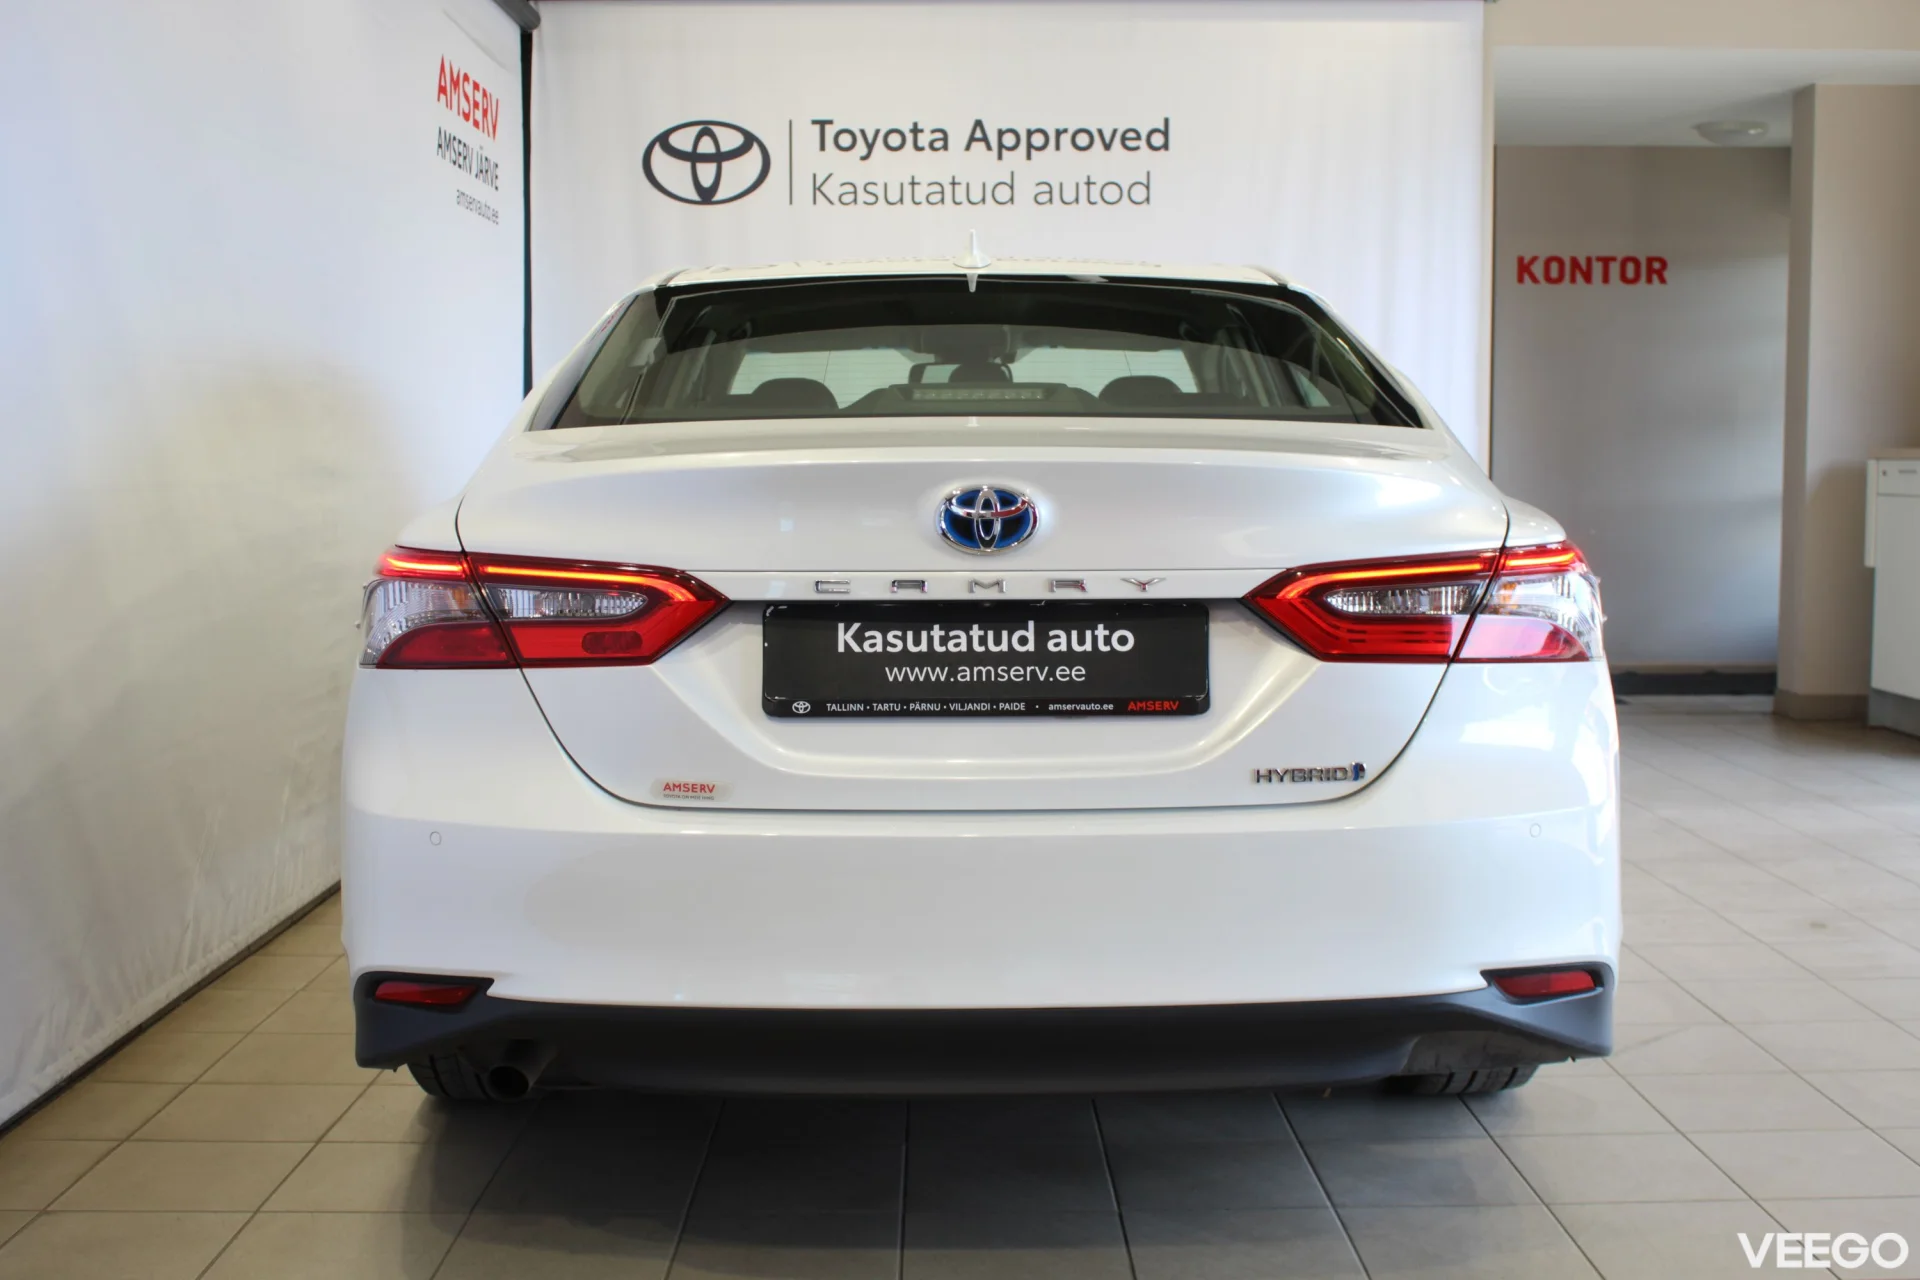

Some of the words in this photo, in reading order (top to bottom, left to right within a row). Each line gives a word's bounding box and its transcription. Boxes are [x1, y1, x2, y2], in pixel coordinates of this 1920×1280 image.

[437, 54, 499, 141] AMSERV
[811, 119, 949, 161] Toyota
[964, 117, 1170, 161] Approved
[437, 126, 473, 175] AMSERV
[475, 145, 499, 192] JÄRVE
[812, 171, 1015, 206] Kasutatud
[1033, 171, 1151, 206] autod
[1516, 255, 1668, 285] KONTOR
[814, 577, 1167, 594] CAMRY
[836, 620, 1035, 653] Kasutatud
[1046, 624, 1135, 653] auto
[884, 661, 1087, 682] www.amserv.ee
[826, 703, 864, 712] TALLINN
[872, 702, 901, 712] TARTU
[909, 701, 941, 711] PÄRNU
[949, 702, 991, 711] VILJANDI
[999, 702, 1026, 711] PAIDE
[1048, 702, 1114, 711] amservauto.ee
[1127, 700, 1180, 711] AMSERV
[663, 782, 716, 794] AMSERV
[1253, 766, 1349, 783] HYBRID
